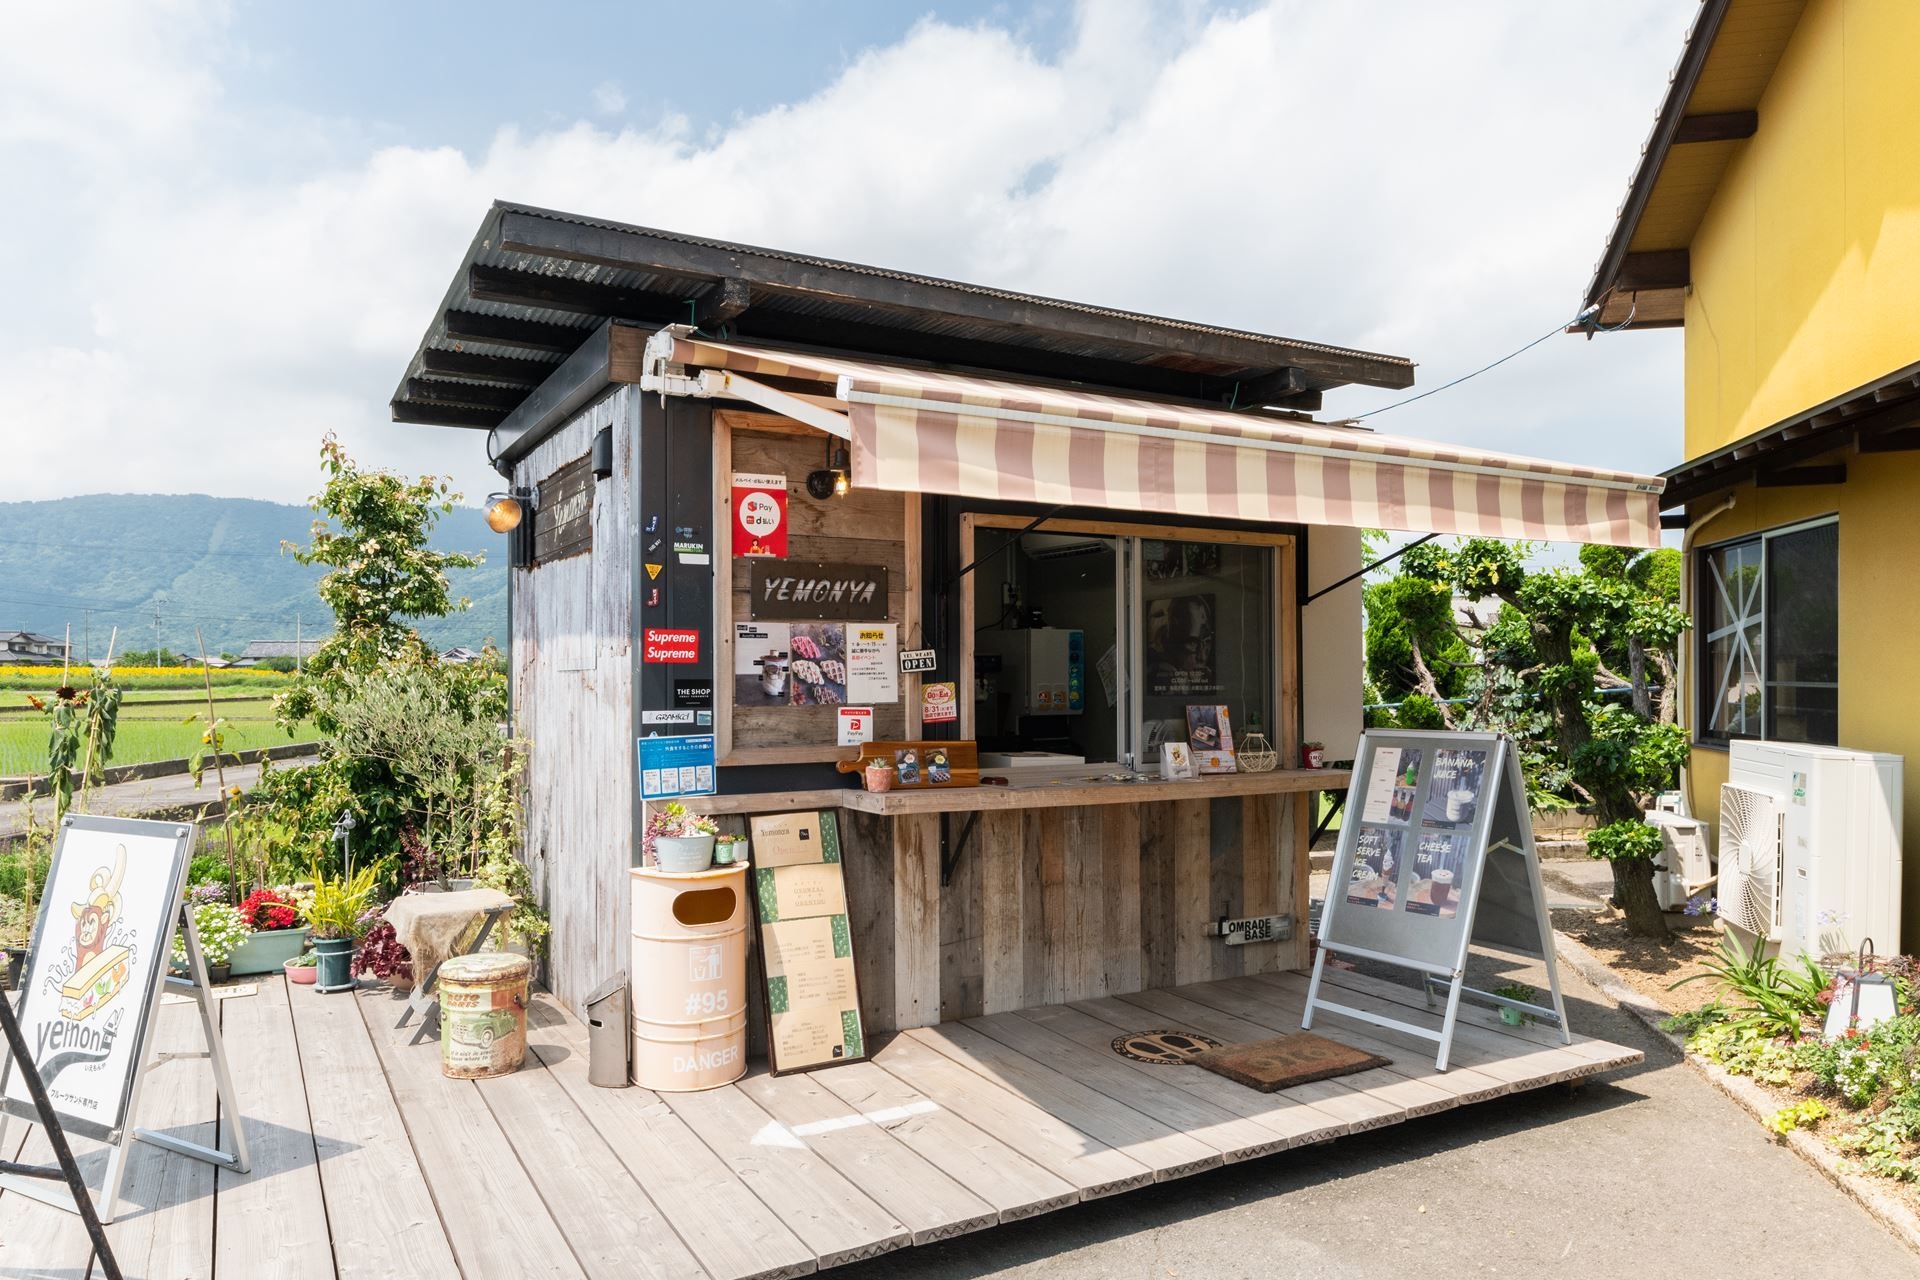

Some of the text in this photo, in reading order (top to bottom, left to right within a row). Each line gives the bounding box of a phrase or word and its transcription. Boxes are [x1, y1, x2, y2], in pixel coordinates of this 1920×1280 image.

[758, 503, 773, 512] Pay
[673, 542, 704, 550] MARUKIN
[763, 576, 877, 604] YEMONYA
[648, 630, 696, 645] Supreme
[647, 647, 695, 662] Supreme
[904, 658, 932, 670] OPEN
[1435, 757, 1474, 769] BANANA
[1433, 770, 1457, 779] JUICE
[1359, 835, 1380, 845] SOFT
[1356, 846, 1381, 857] SERVE
[1418, 842, 1452, 853] CHEESE
[1353, 858, 1368, 867] ICE
[1416, 853, 1433, 865] TEA
[1352, 869, 1379, 881] CREAM
[1245, 929, 1271, 941] BASE
[685, 989, 729, 1015] #95
[672, 1046, 738, 1073] DANGER
[50, 1089, 99, 1110] フルーツサンド専門店
